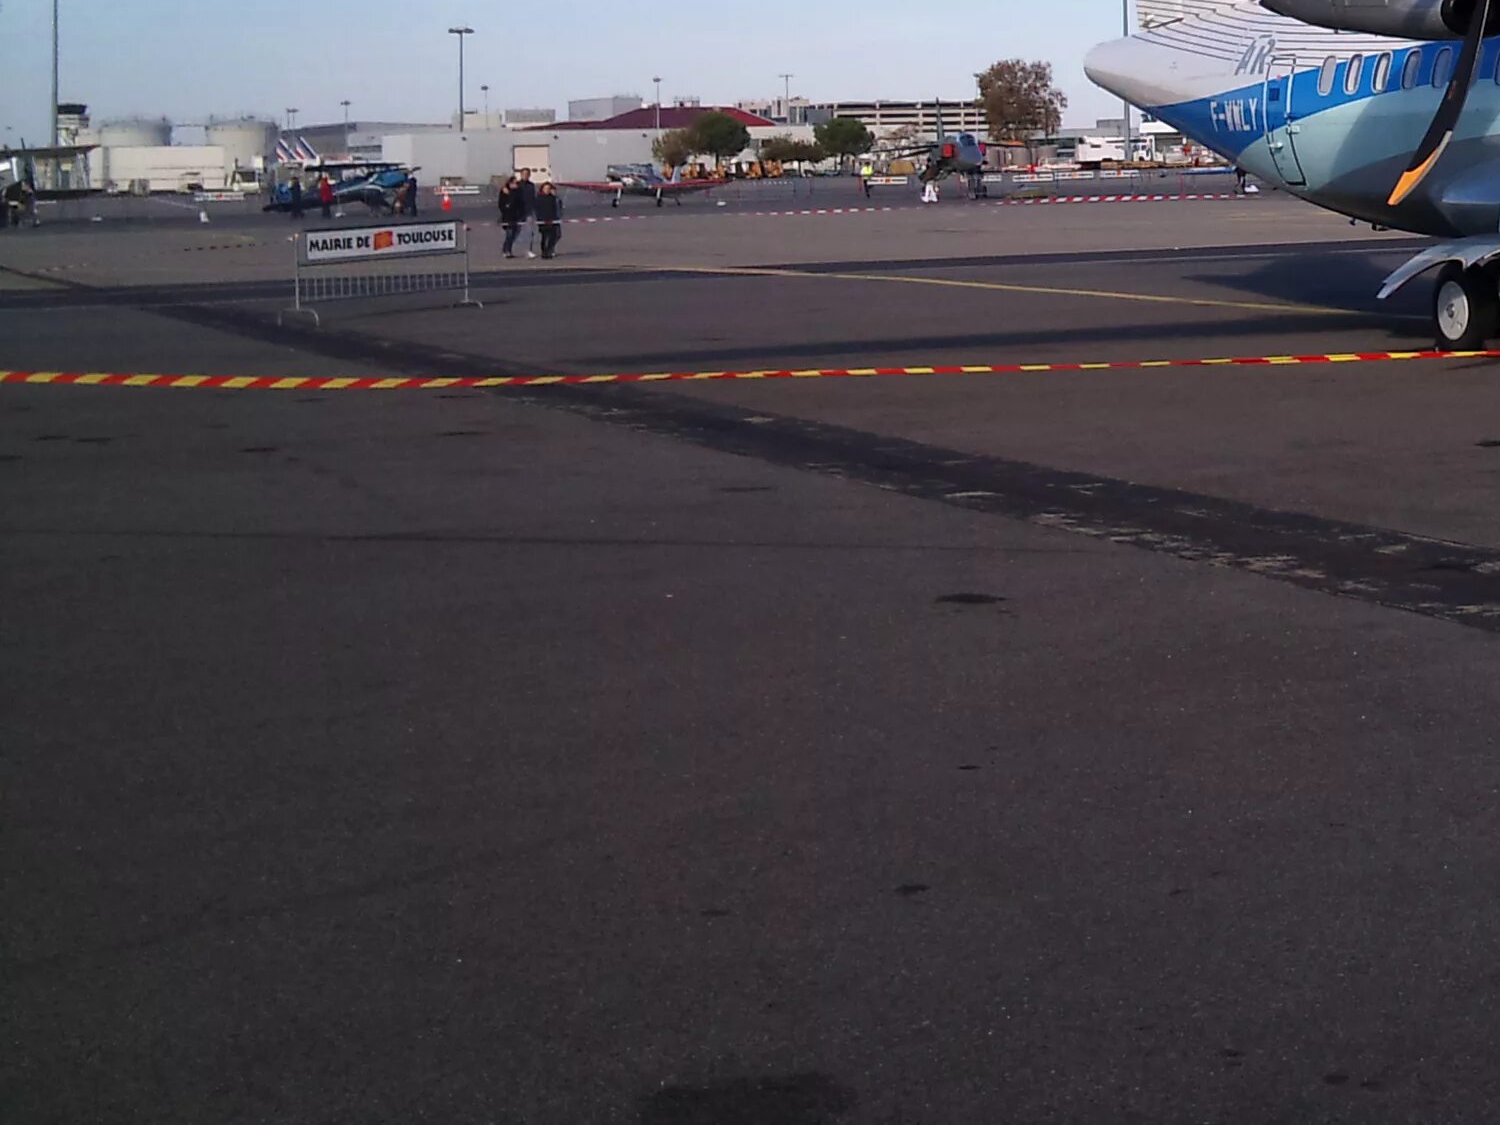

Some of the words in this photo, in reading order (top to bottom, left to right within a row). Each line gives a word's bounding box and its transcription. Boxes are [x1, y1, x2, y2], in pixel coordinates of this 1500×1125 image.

[309, 237, 353, 252] MAIRIE
[356, 236, 371, 249] DE
[397, 229, 454, 245] TOULOUSE
